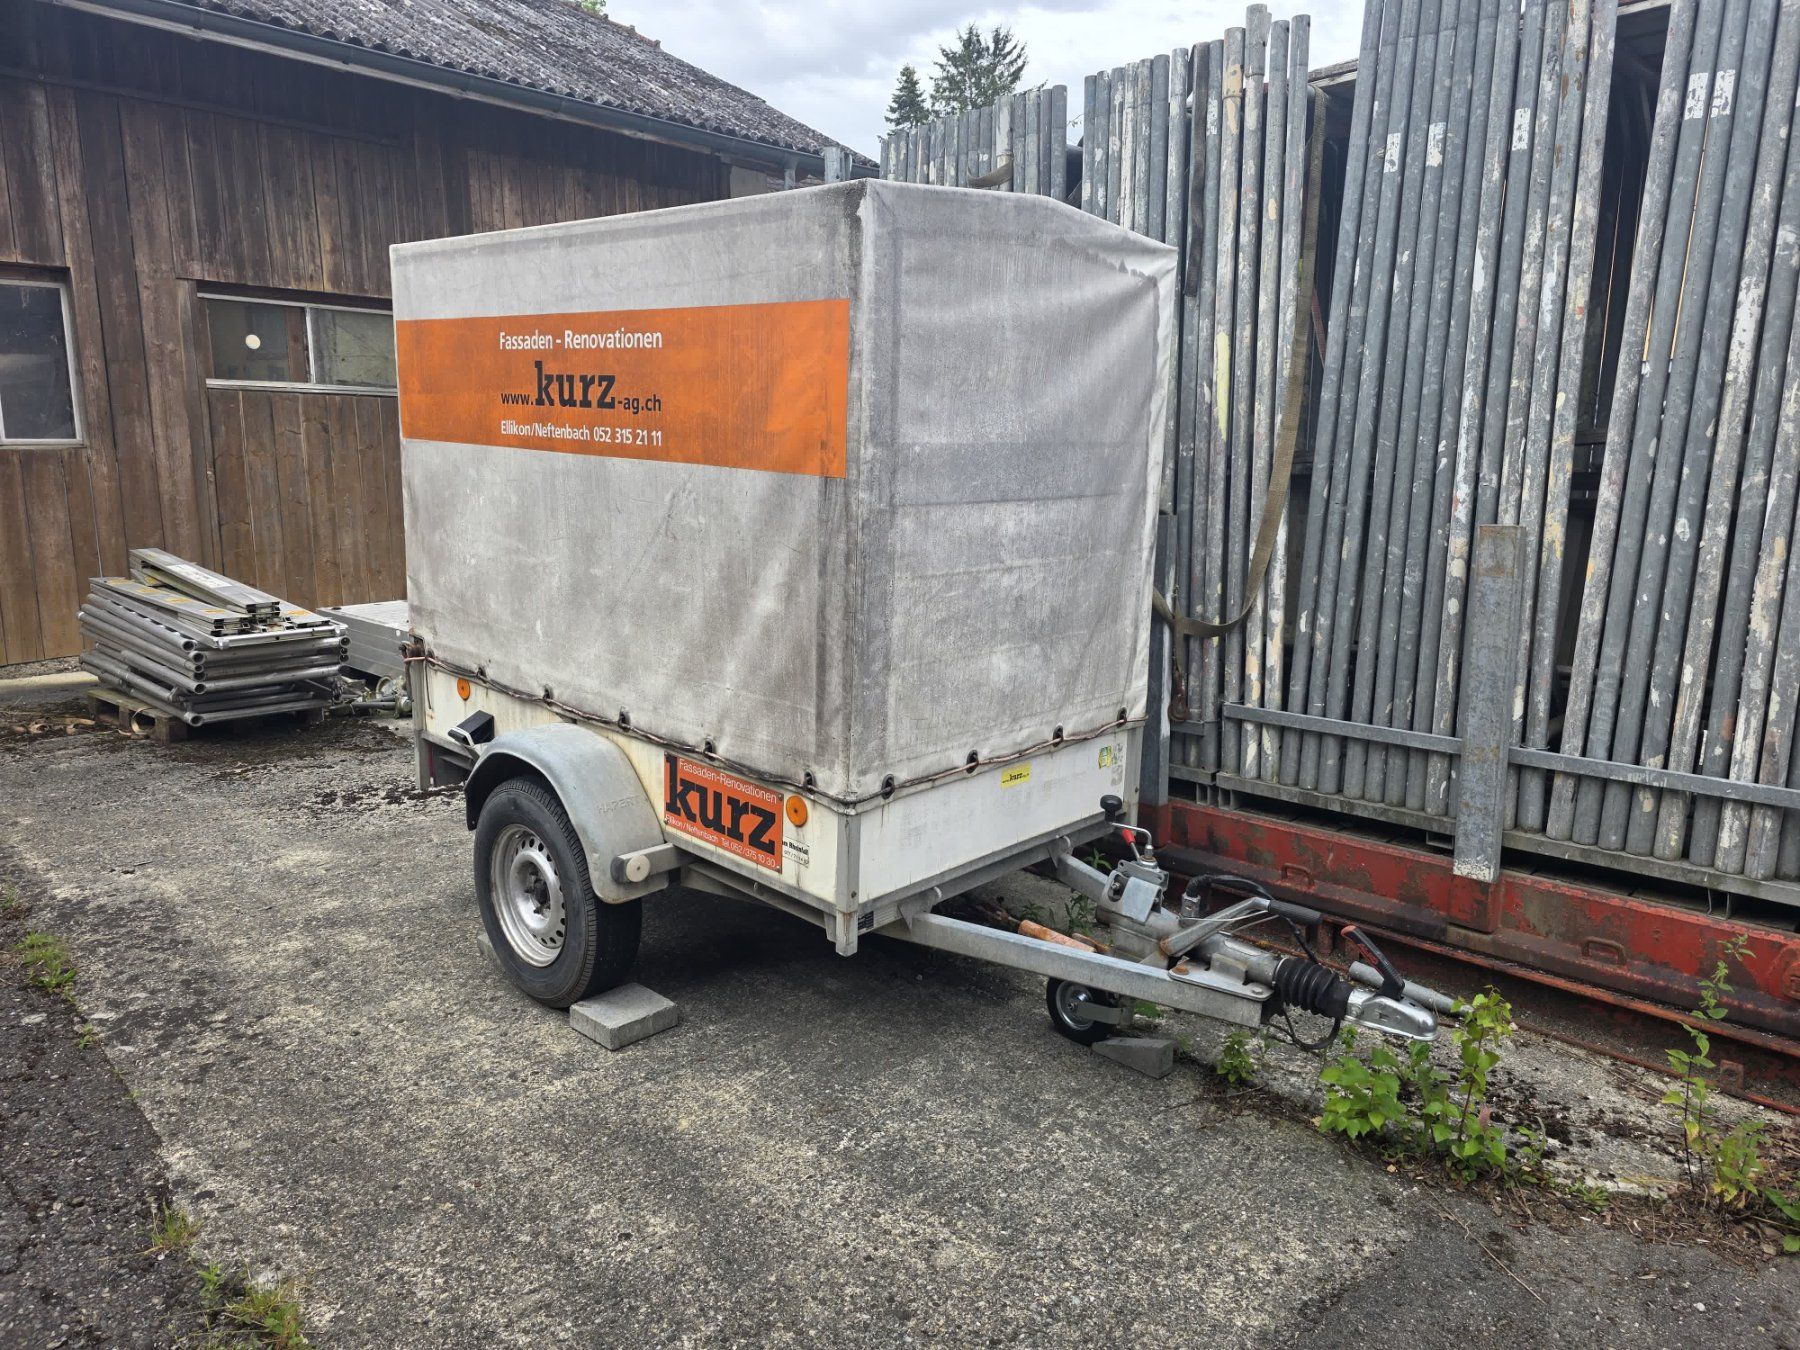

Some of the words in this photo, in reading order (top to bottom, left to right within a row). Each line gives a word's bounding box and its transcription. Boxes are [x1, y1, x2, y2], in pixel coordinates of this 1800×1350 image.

[500, 330, 553, 350] Fassaden
[564, 328, 662, 349] Renovationen
[501, 420, 590, 441] Ellikon/Neftenbach
[593, 427, 611, 443] 052
[615, 428, 632, 444] 315
[636, 429, 647, 445] 21
[651, 430, 662, 446] 11
[679, 759, 777, 805] Fassaden-Renovationen
[666, 754, 776, 856] kurz
